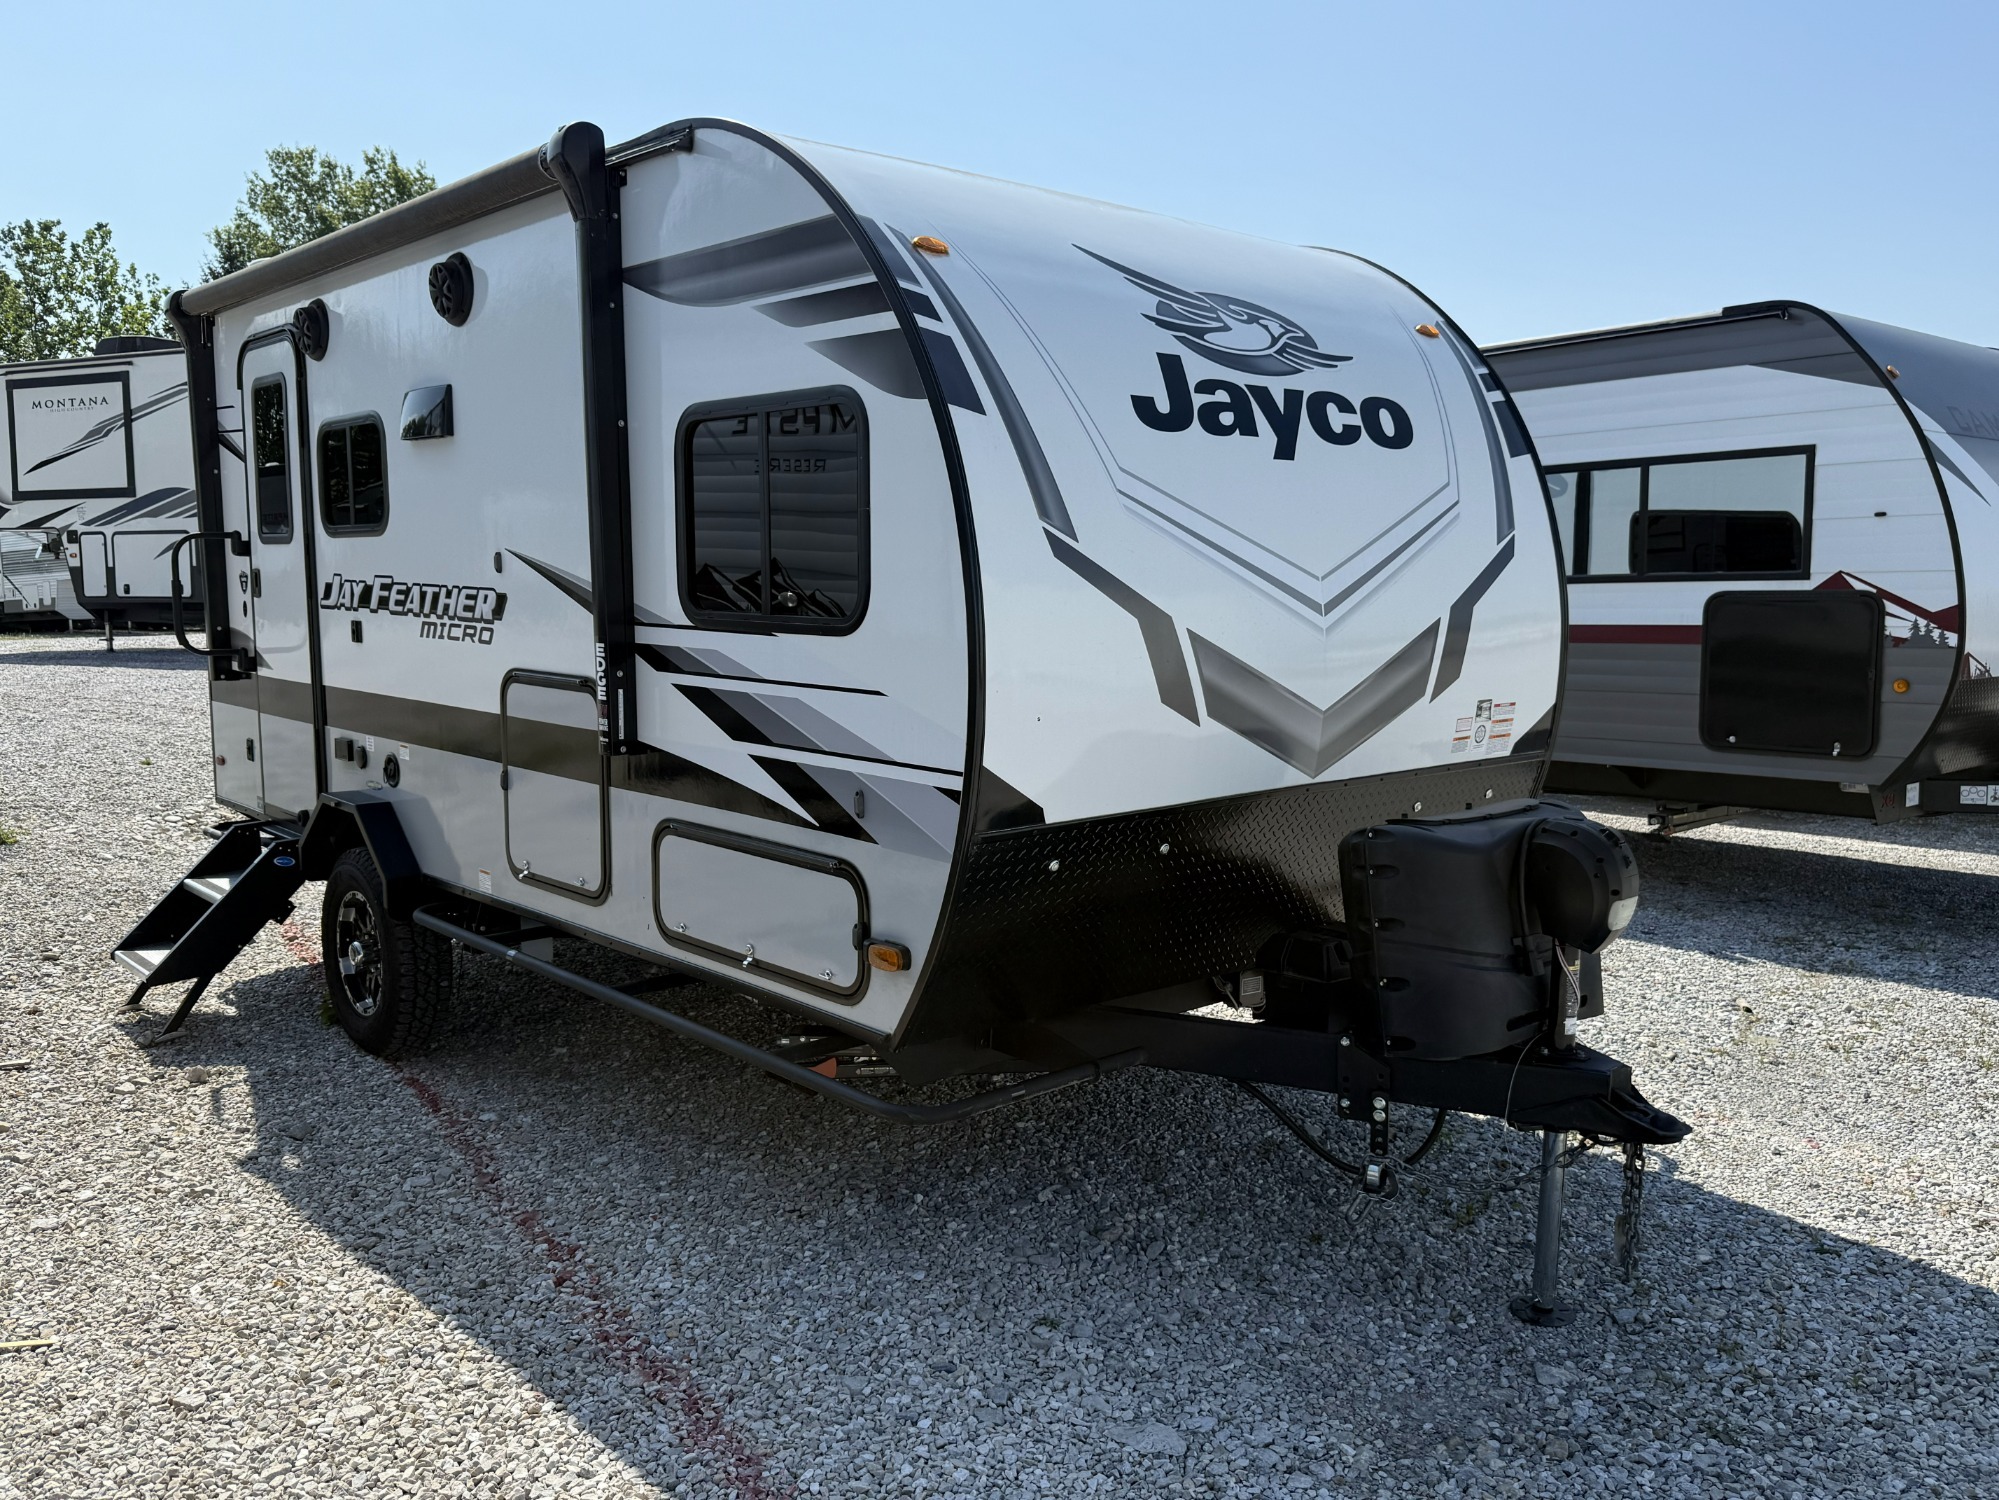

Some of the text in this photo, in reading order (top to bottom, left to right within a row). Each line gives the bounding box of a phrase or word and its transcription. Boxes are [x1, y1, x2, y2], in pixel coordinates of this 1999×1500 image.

[31, 395, 109, 410] MONTANA
[1130, 351, 1414, 461] Jayco
[320, 573, 498, 625] JAY FEATHER
[419, 620, 495, 646] MICRO
[595, 642, 607, 701] EDGE
